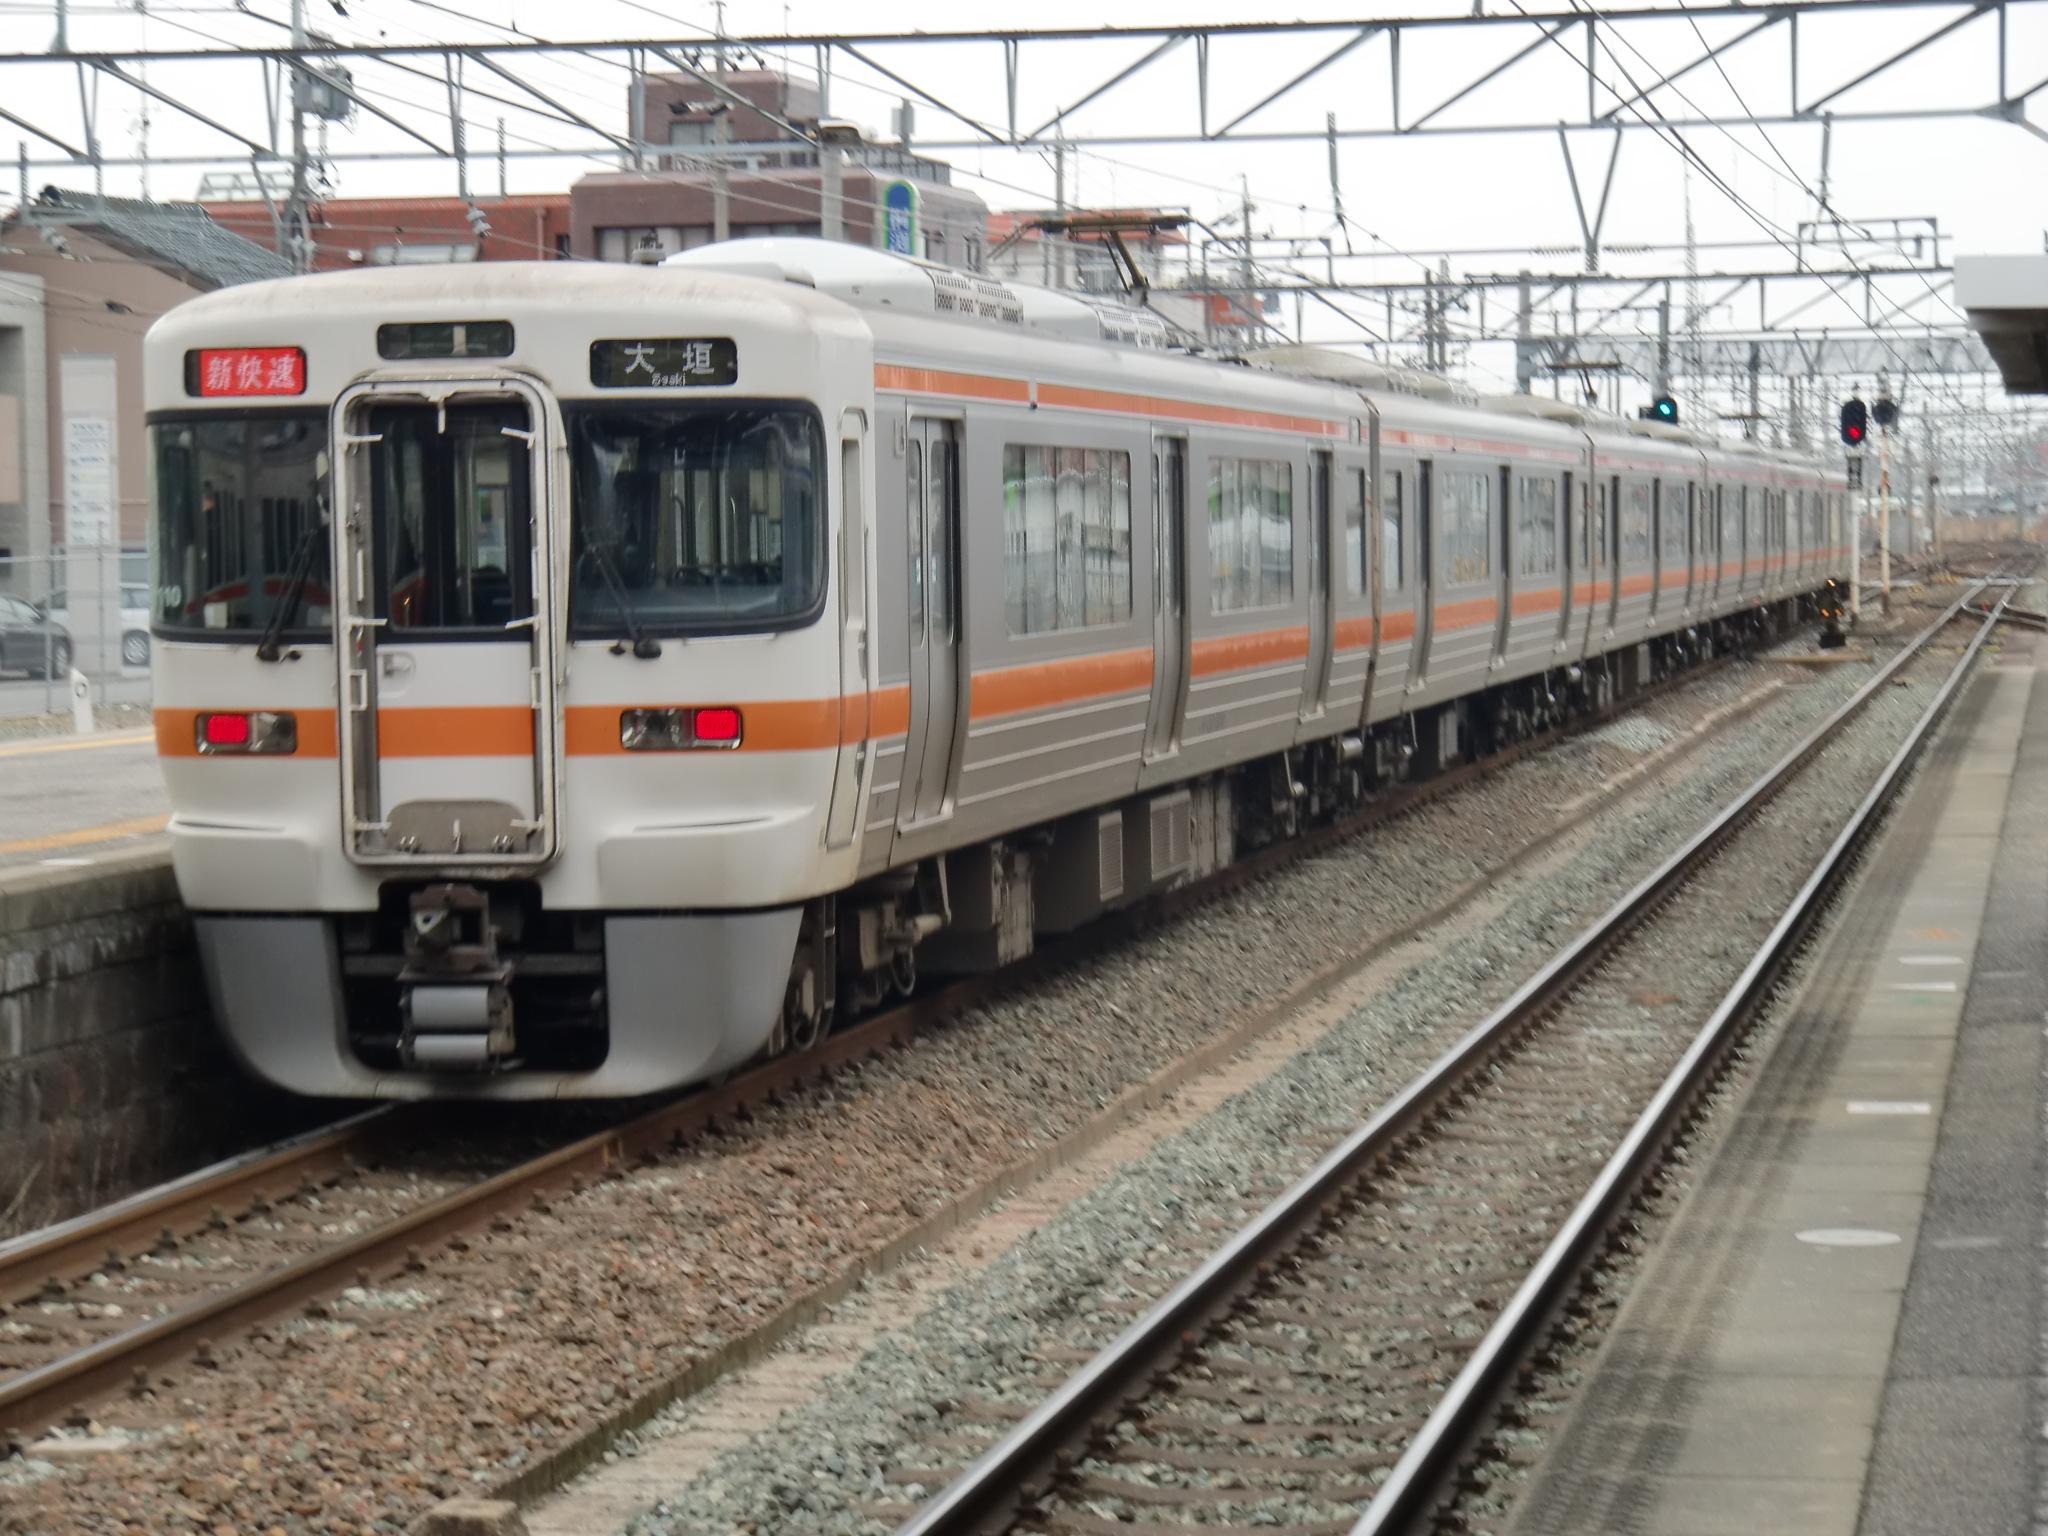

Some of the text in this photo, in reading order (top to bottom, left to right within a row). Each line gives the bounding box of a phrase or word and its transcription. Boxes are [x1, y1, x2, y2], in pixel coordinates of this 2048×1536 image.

[207, 355, 296, 390] 新快速
[624, 342, 714, 374] 大垣
